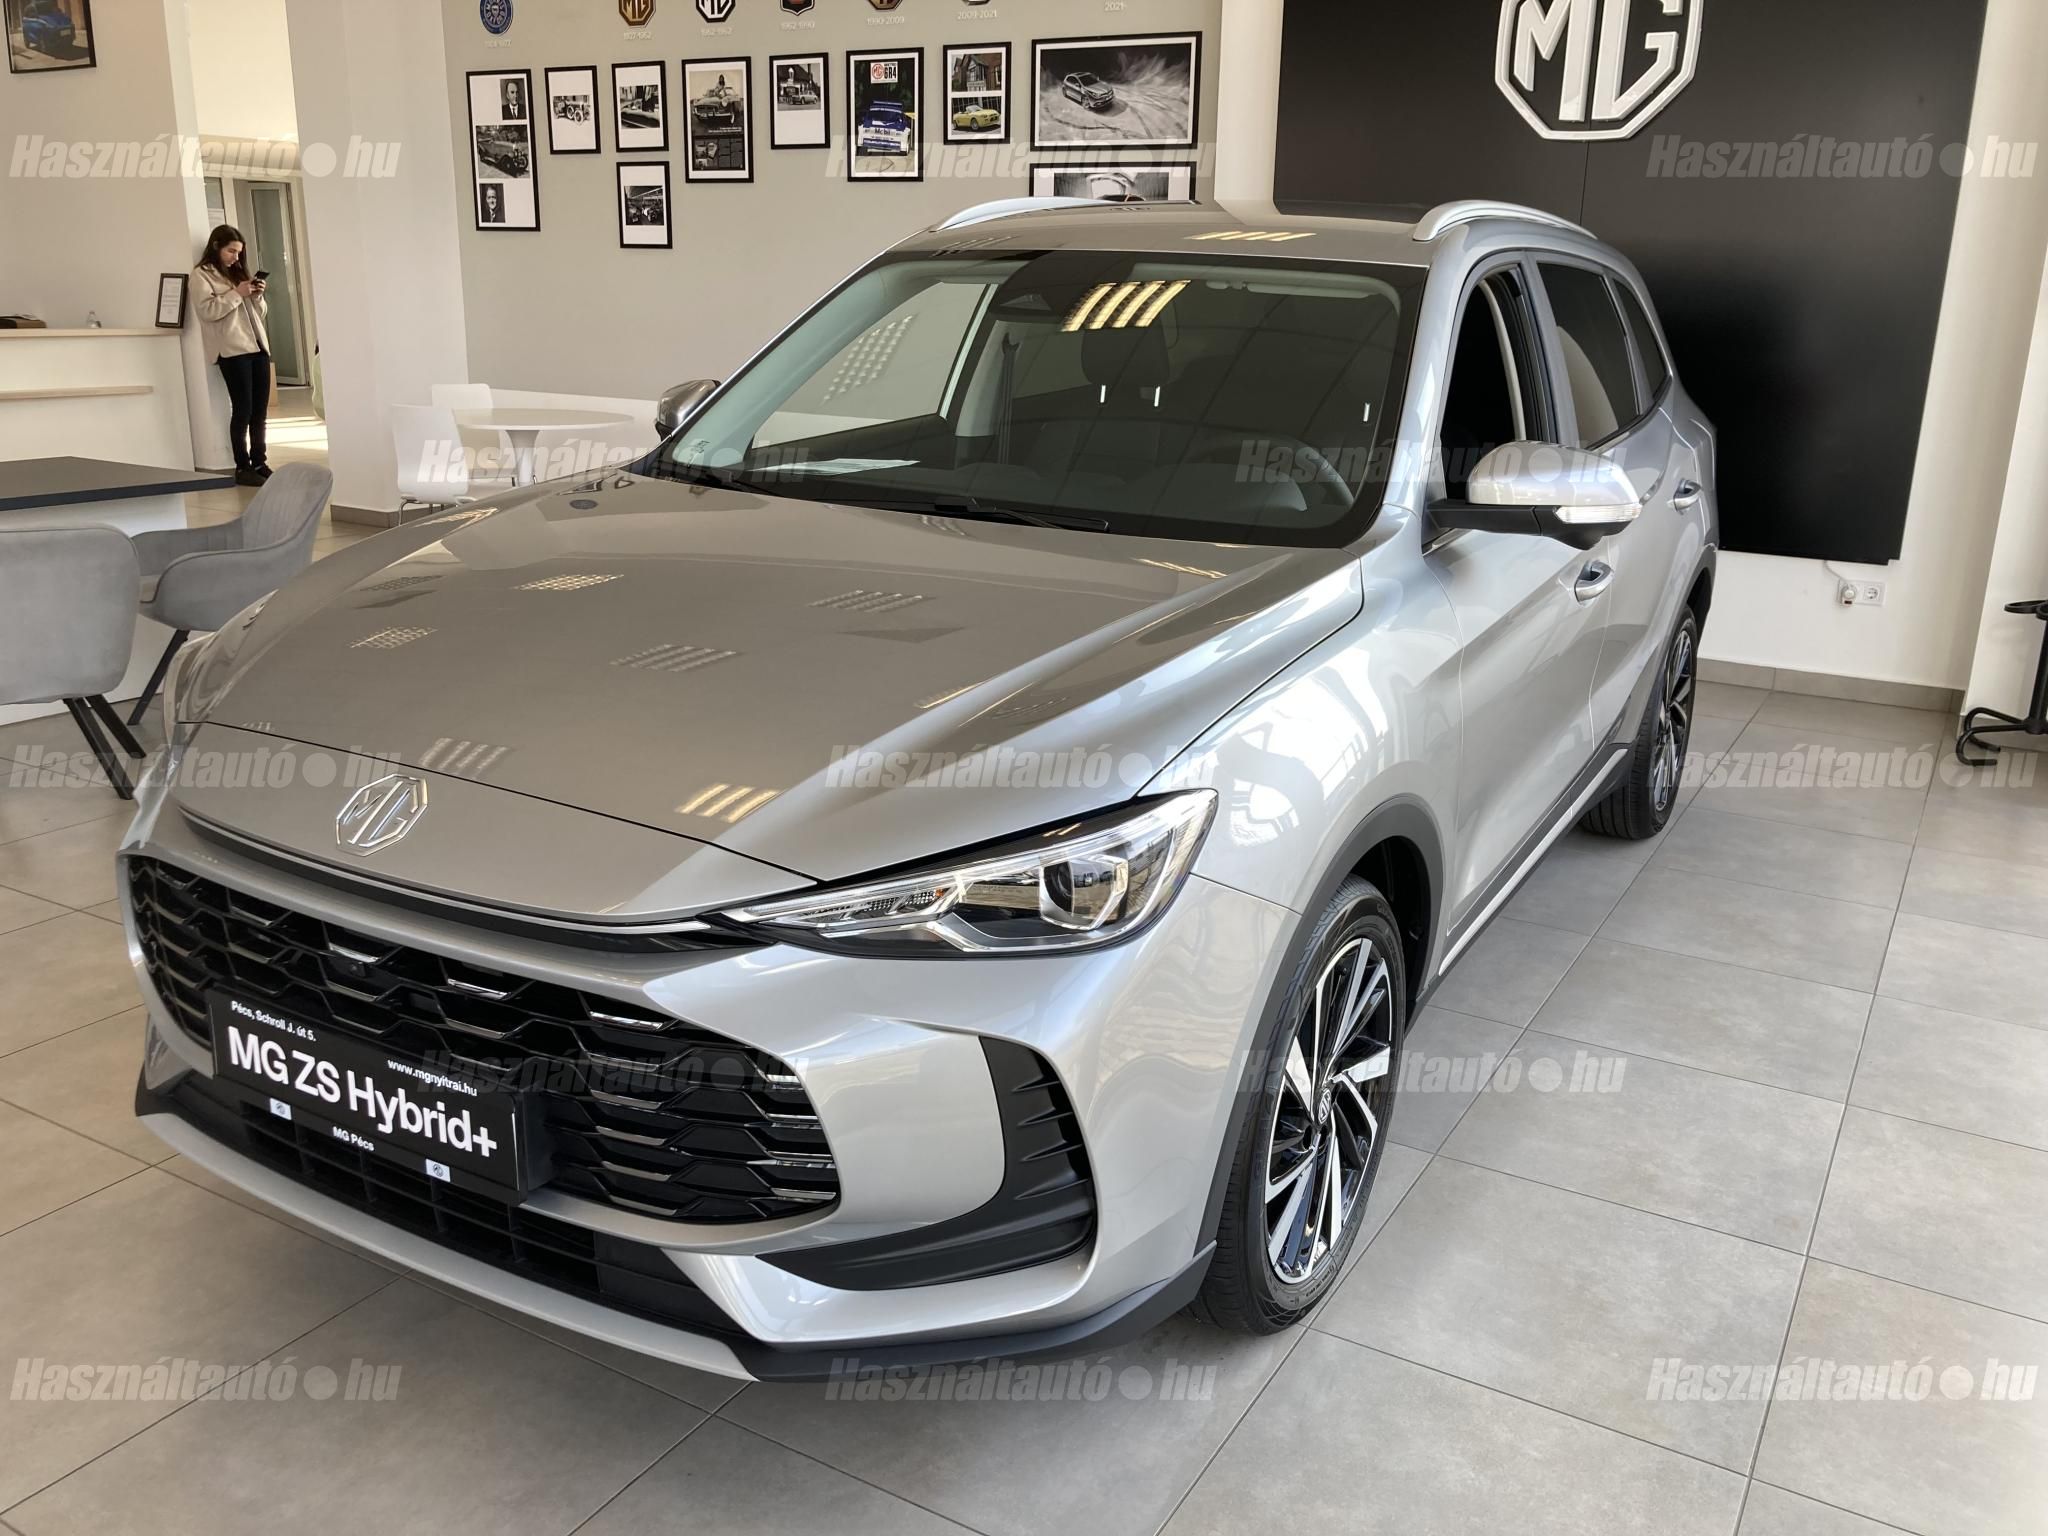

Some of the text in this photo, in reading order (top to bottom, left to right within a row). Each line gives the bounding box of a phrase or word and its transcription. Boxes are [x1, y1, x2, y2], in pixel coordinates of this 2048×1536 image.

[1514, 0, 1684, 122] MG
[231, 1000, 255, 1020] Pécs,
[255, 1010, 286, 1030] Schroll
[287, 1022, 295, 1034] J.
[307, 1029, 317, 1042] 5.
[228, 1026, 497, 1158] MG ZS Hybrid+
[387, 1059, 478, 1097] www.mgnyitrai.hu
[333, 1126, 375, 1151] MG Pécs
